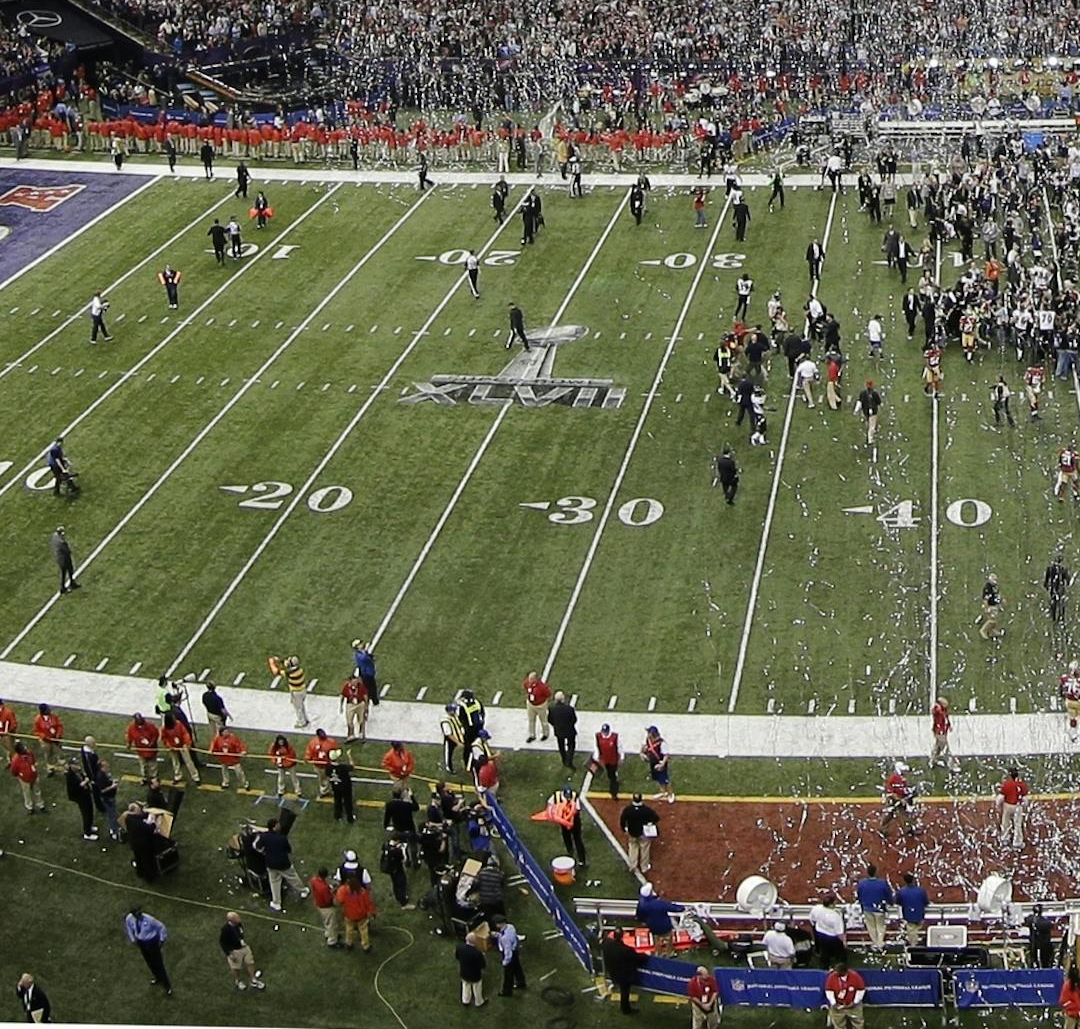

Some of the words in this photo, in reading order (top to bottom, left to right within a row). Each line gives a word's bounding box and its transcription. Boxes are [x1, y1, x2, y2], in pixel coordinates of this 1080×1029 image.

[397, 380, 628, 409] XLVII
[238, 481, 353, 512] 20
[548, 495, 664, 526] 30
[876, 499, 993, 527] 40
